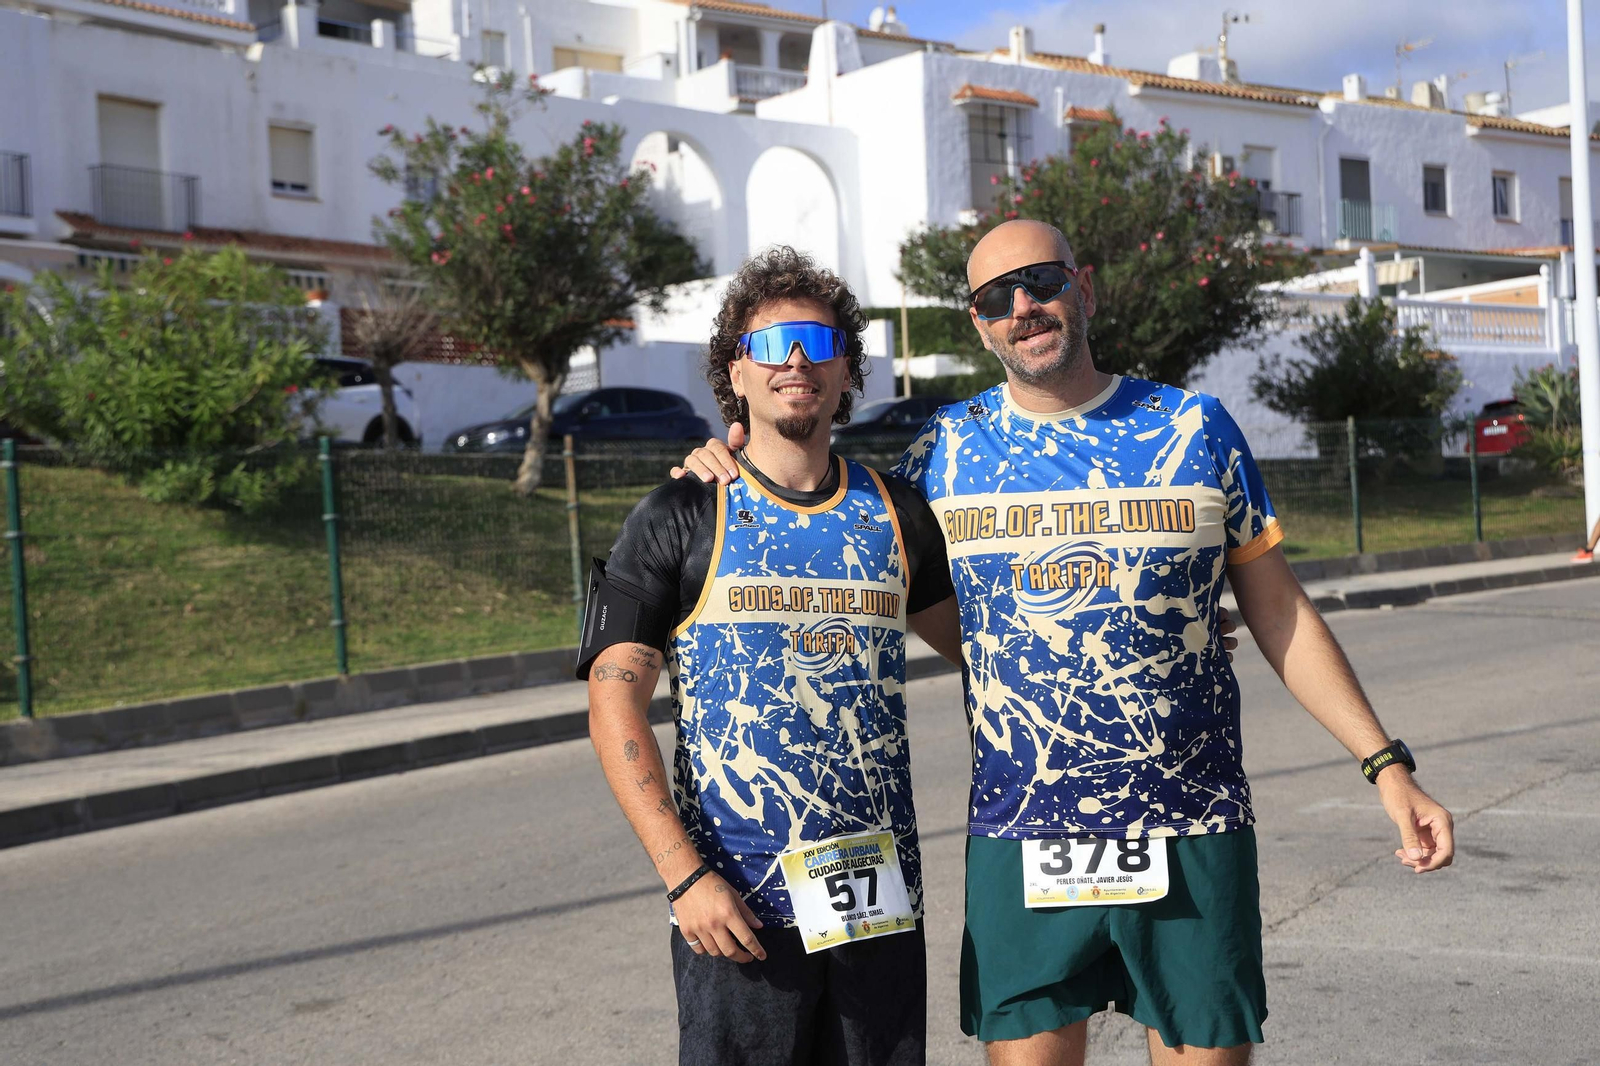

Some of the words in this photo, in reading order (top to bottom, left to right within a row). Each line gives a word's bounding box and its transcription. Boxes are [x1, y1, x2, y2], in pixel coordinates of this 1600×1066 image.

[1132, 400, 1172, 413] SPALL
[854, 524, 882, 532] SPALL
[1011, 561, 1111, 590] TARIFA
[790, 631, 855, 654] TARIFA
[803, 849, 815, 859] XXV
[816, 842, 840, 854] EDICIÓN
[804, 848, 849, 869] CARRERA
[848, 843, 881, 858] URBANA
[1039, 838, 1151, 876] 378
[808, 861, 842, 879] CIUDAD
[842, 860, 851, 870] DE
[851, 854, 885, 869] ALGECIRAS
[824, 867, 878, 912] 57
[1077, 876, 1095, 885] OÑATE,
[1096, 876, 1115, 884] JAVIER
[1116, 874, 1133, 883] JESÚS
[868, 908, 885, 917] ISMAEL
